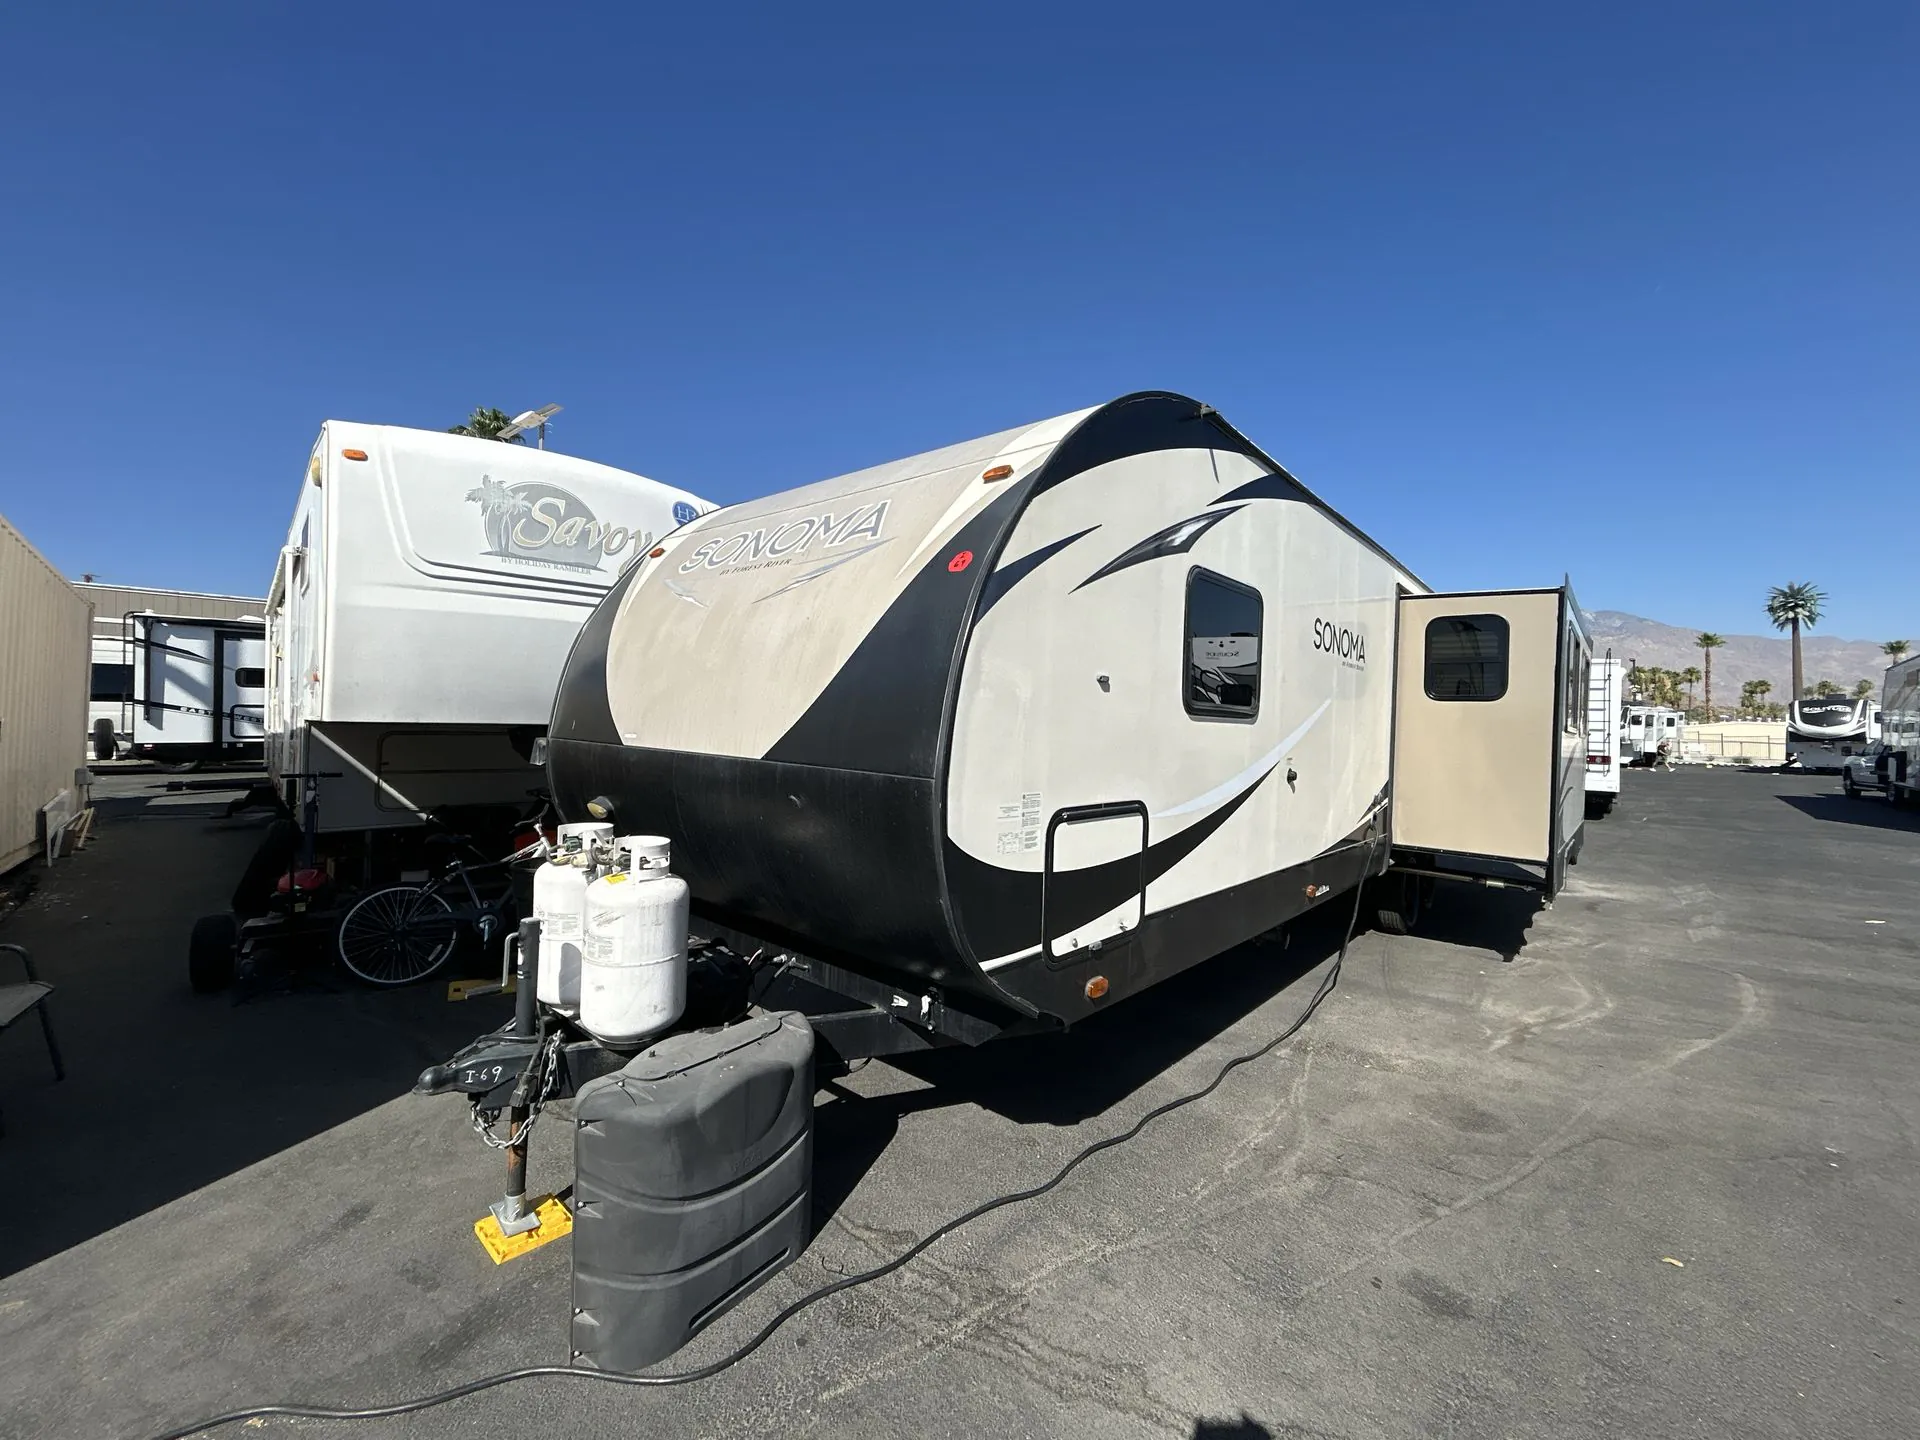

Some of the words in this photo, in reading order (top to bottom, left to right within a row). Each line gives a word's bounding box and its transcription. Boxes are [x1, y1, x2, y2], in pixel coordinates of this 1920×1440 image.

[512, 497, 653, 577] Savoy
[678, 499, 892, 574] SONOMA
[501, 556, 514, 565] BY
[515, 558, 552, 569] HOLIDAY
[553, 563, 592, 575] RAMBLER
[763, 558, 792, 569] RIVER
[1312, 617, 1366, 664] SONOMA
[465, 1065, 503, 1083] I-69
